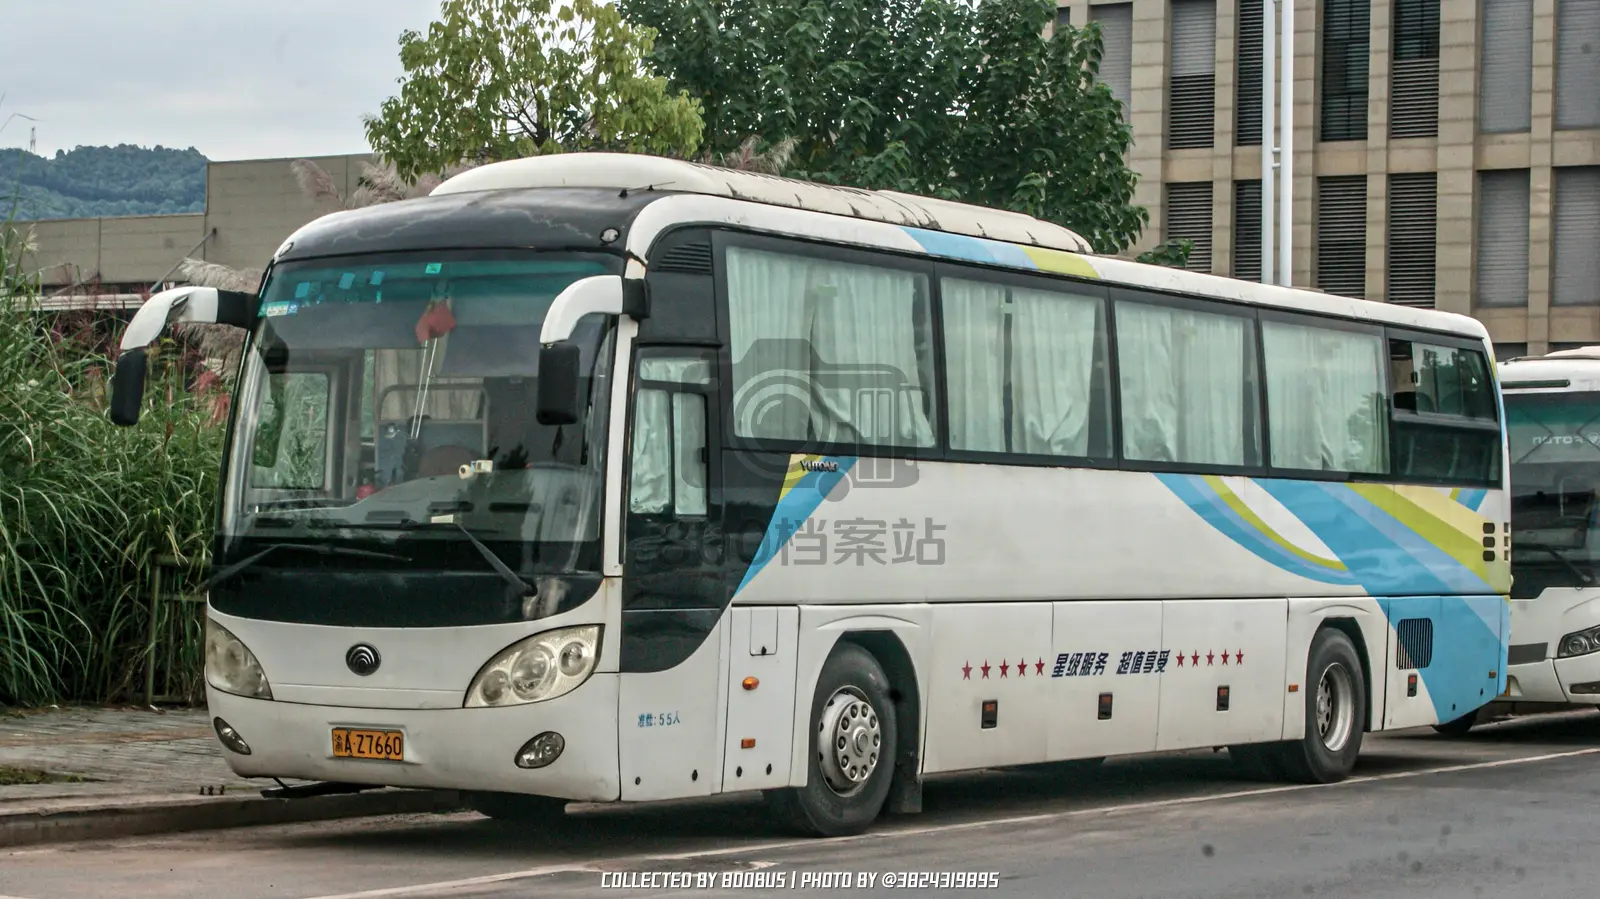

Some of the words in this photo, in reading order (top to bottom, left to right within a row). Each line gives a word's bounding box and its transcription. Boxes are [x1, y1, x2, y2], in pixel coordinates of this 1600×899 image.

[800, 460, 839, 472] YUTONG
[1051, 652, 1109, 678] 星级服务
[1115, 649, 1171, 675] 超值享受
